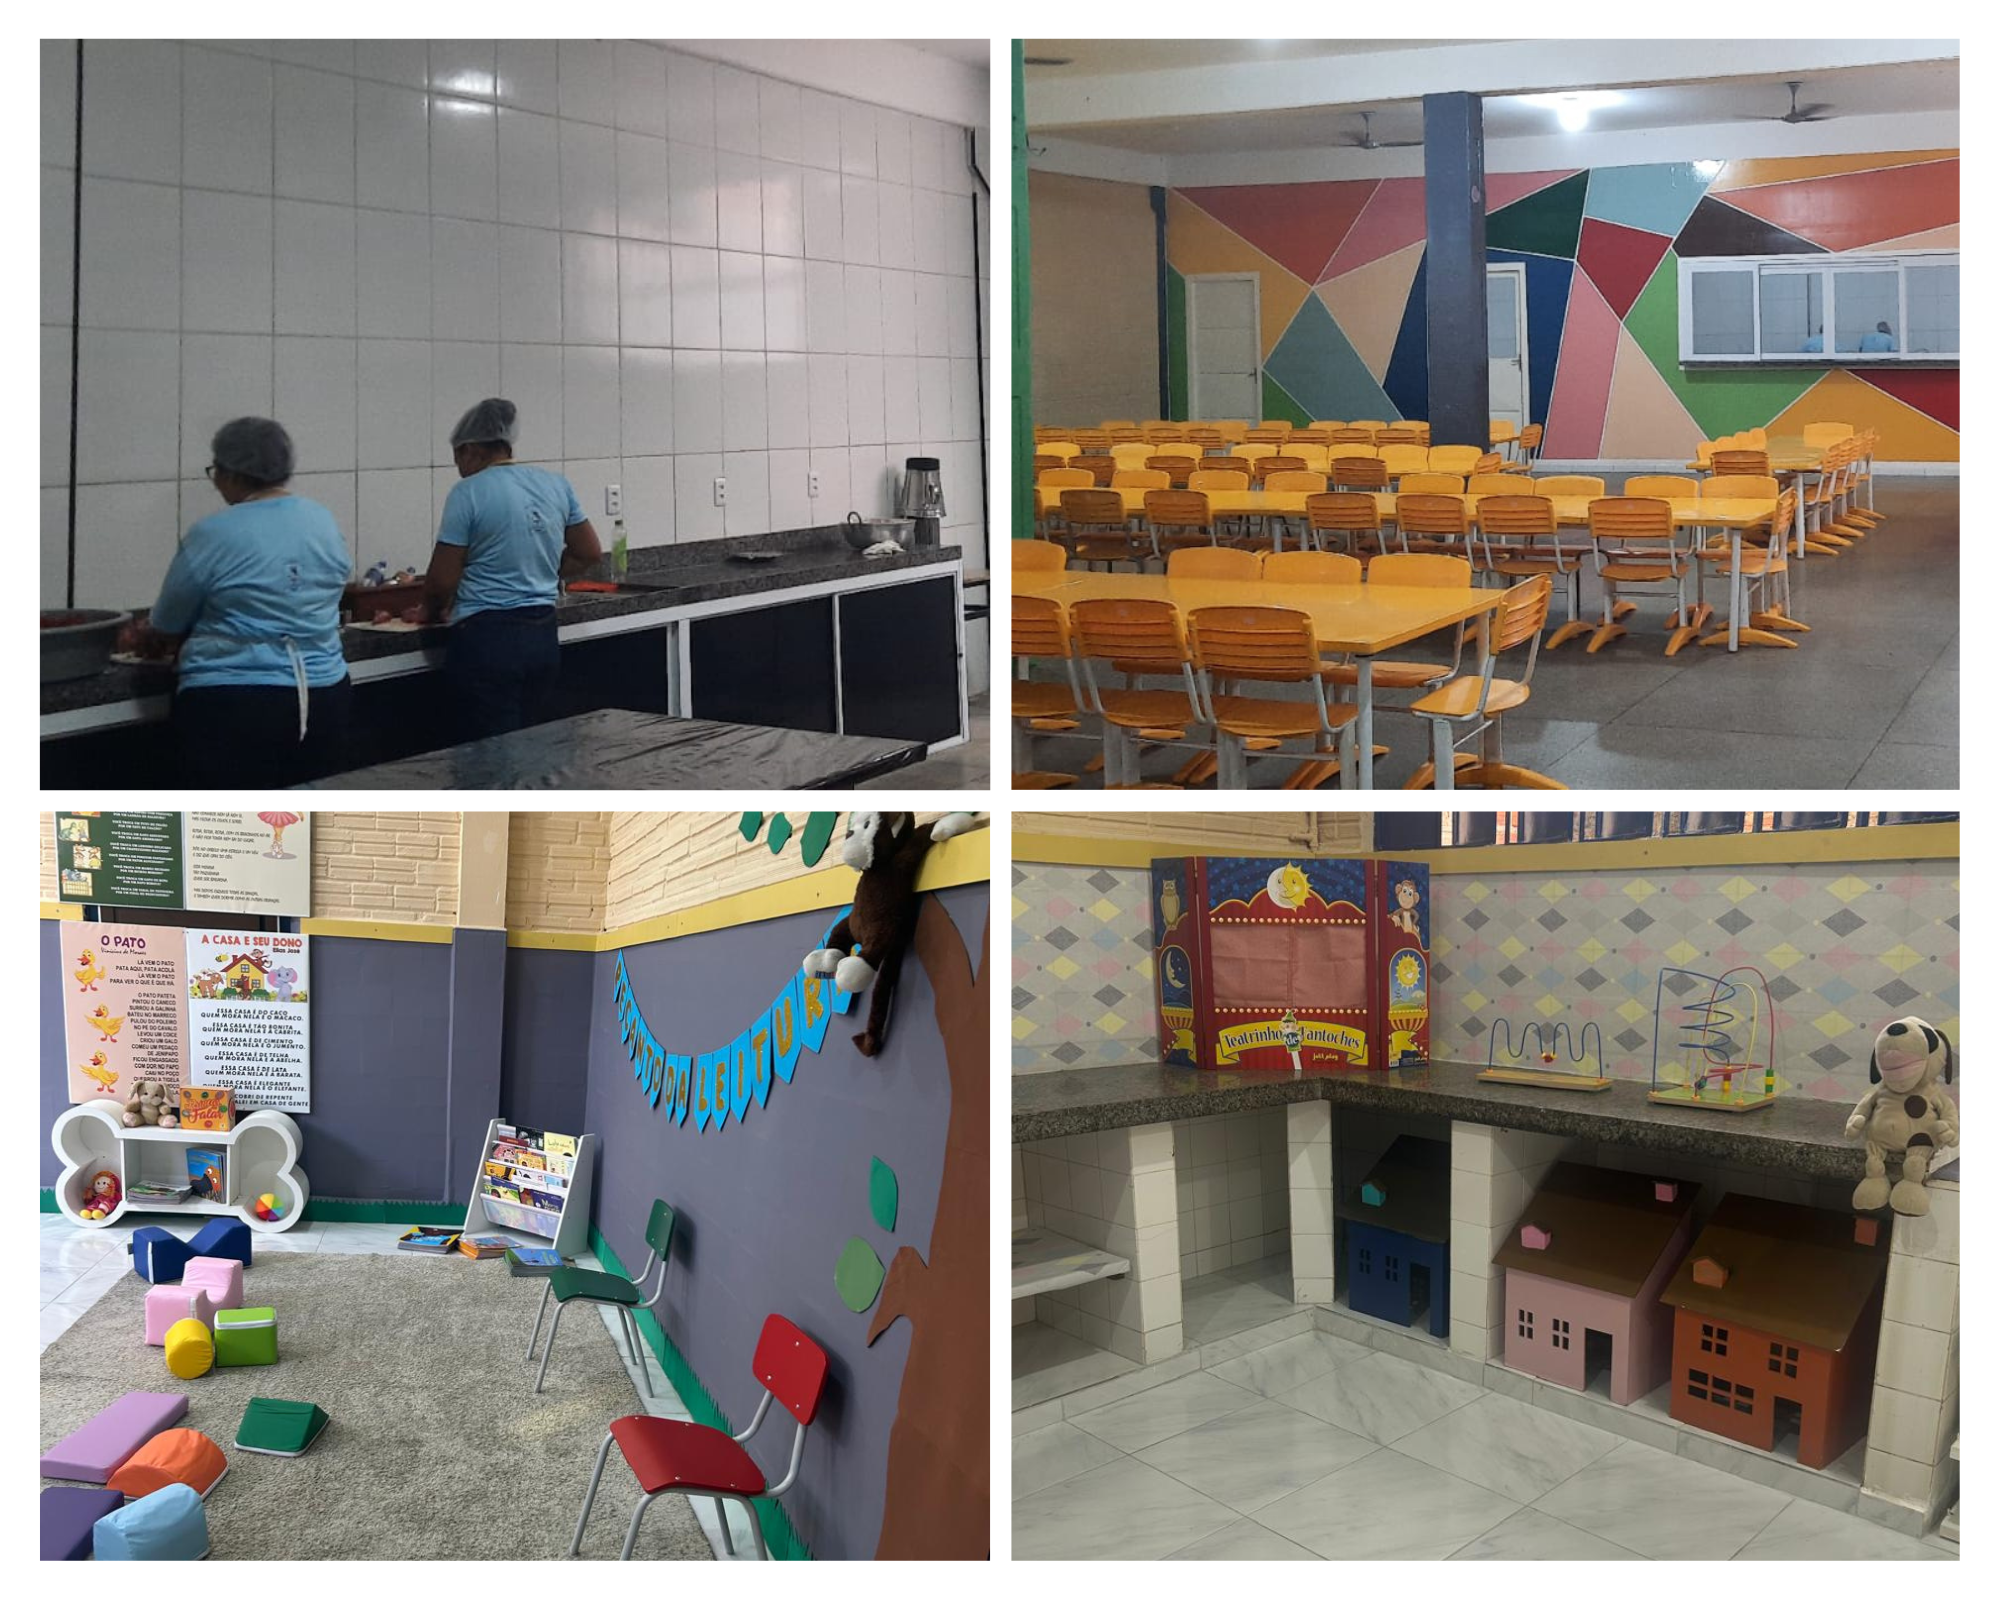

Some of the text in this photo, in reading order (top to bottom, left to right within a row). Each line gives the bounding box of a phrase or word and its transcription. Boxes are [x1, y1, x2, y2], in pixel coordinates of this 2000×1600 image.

[114, 936, 146, 949] PATO
[201, 935, 302, 948] A CASA E SEU DONO
[615, 945, 857, 1111] RECANTO DA LEITUR
[1224, 1026, 1282, 1048] Teatrinho
[1287, 1034, 1299, 1045] de
